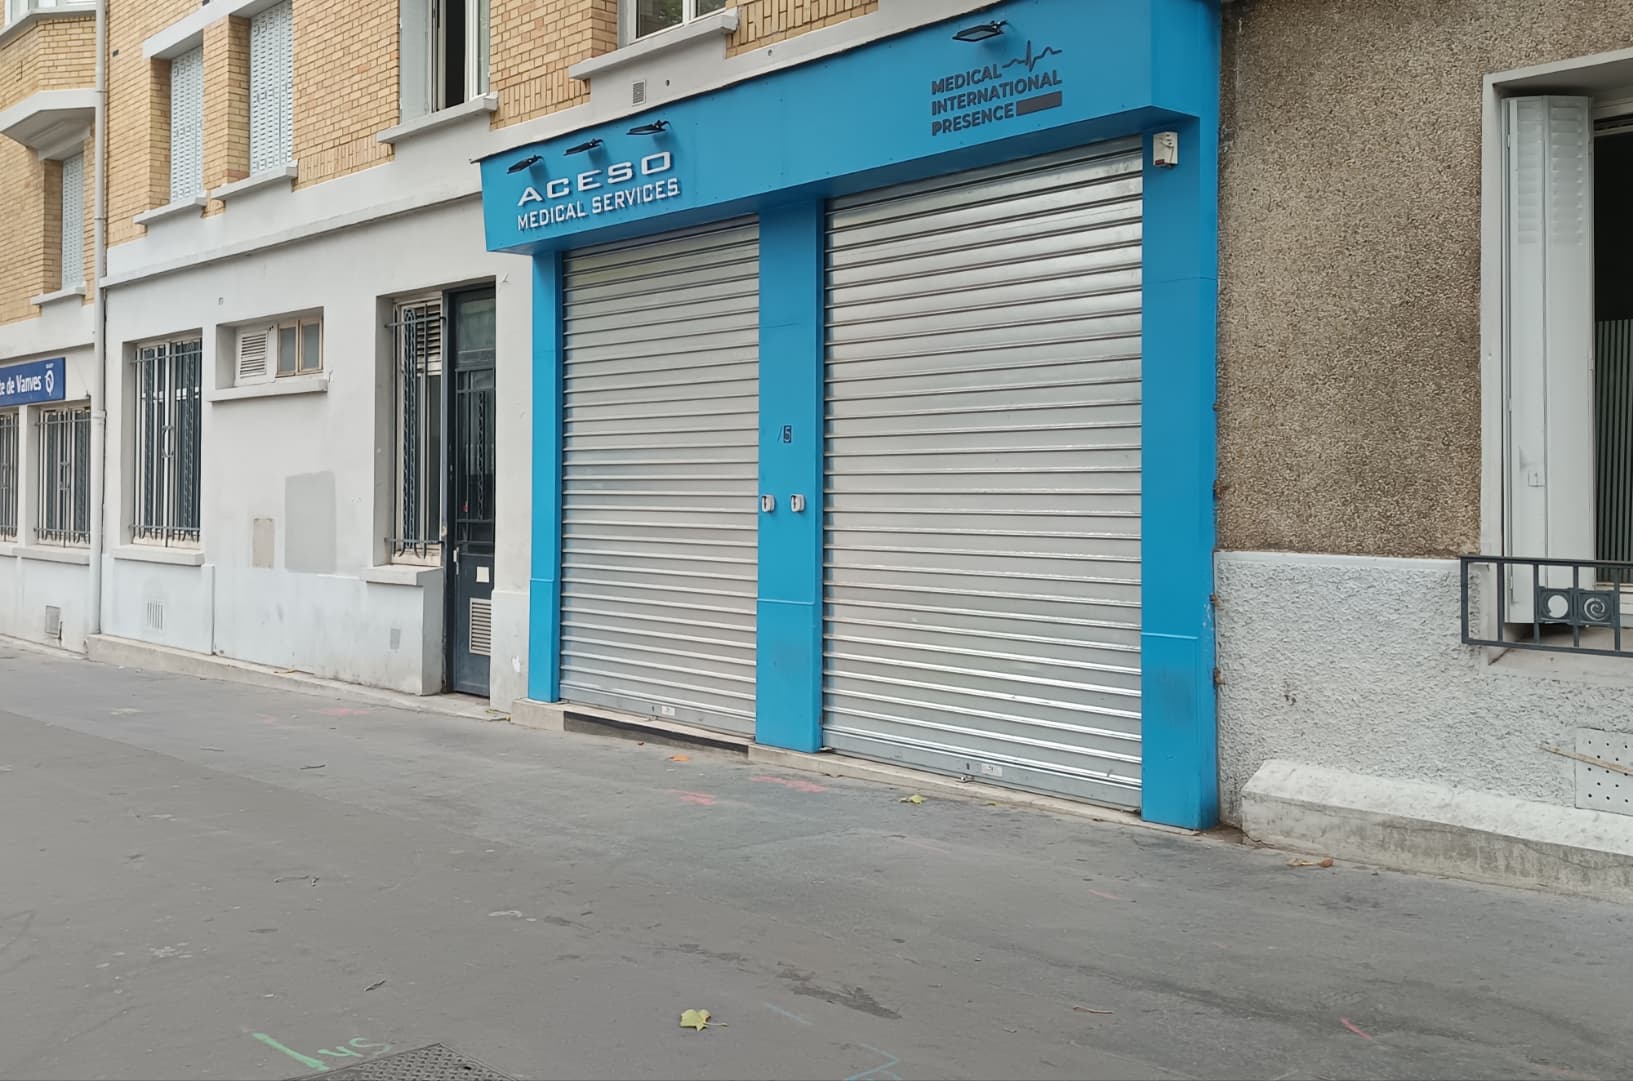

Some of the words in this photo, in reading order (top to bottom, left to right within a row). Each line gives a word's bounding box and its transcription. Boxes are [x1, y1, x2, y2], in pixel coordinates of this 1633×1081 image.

[931, 63, 1002, 95] MEDICAL
[931, 69, 1063, 116] INTERNATIONAL
[931, 102, 1014, 136] PRESENCE
[517, 151, 671, 207] ACESO
[517, 201, 587, 231] MEDICAL
[591, 177, 680, 214] SERVICES
[6, 376, 15, 395] de
[15, 374, 42, 393] Vanves
